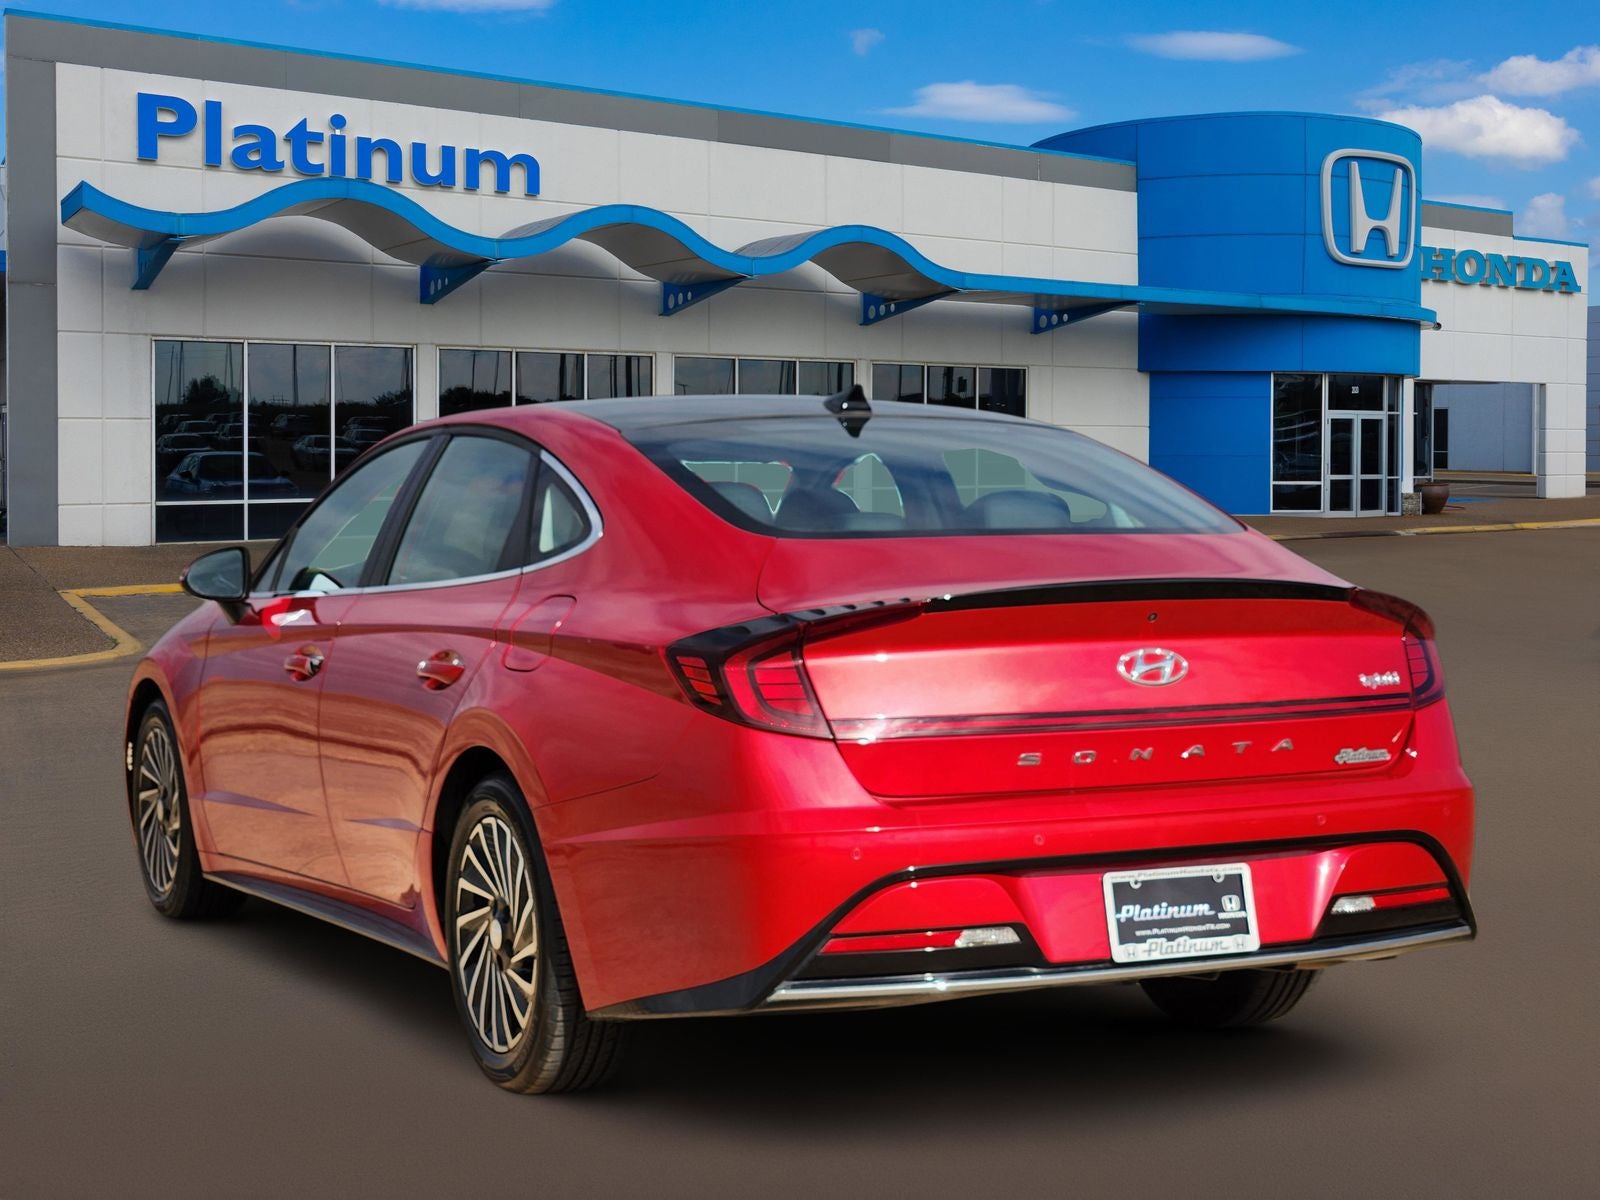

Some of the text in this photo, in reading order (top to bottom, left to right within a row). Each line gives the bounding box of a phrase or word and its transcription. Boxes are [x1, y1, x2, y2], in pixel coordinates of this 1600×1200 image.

[137, 92, 540, 195] Platinum
[1421, 246, 1581, 292] HONDA
[1016, 738, 1294, 766] SONATA
[1335, 747, 1391, 764] Platinum
[1116, 902, 1215, 923] Platinum
[1142, 939, 1229, 957] Platinum
